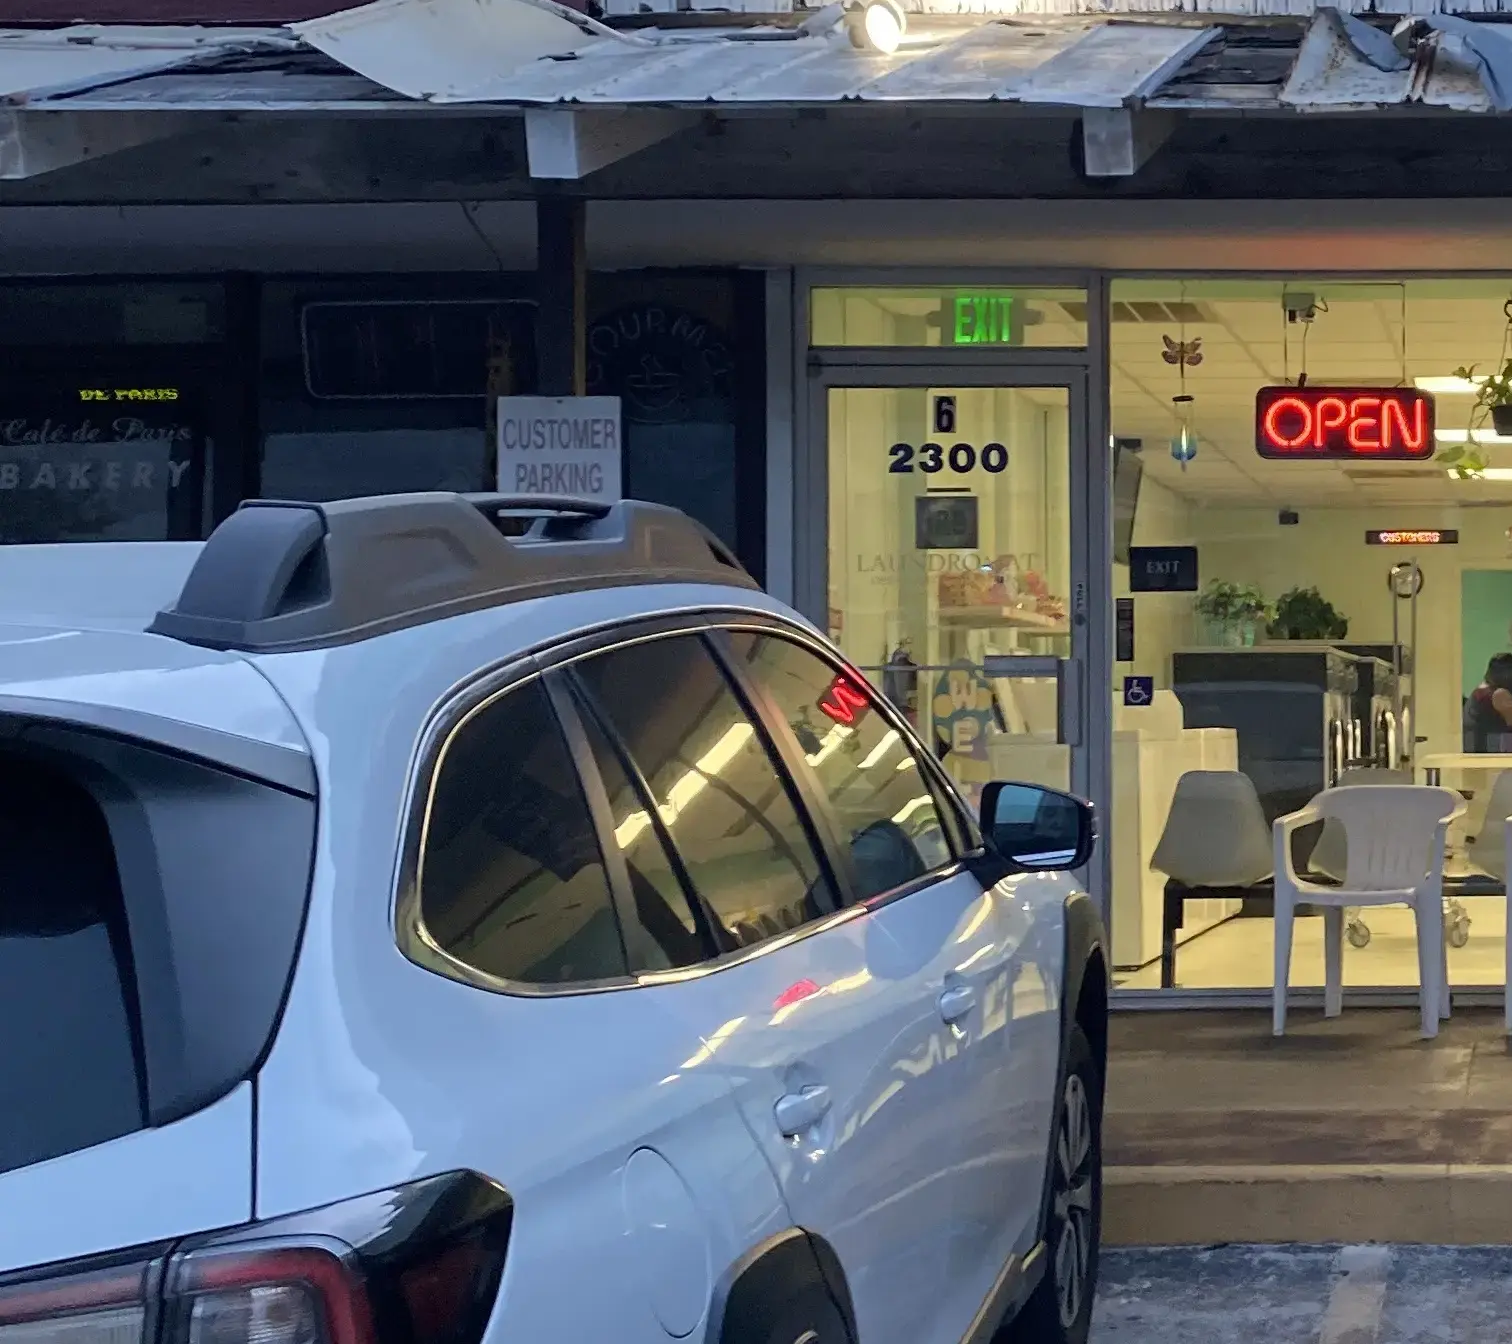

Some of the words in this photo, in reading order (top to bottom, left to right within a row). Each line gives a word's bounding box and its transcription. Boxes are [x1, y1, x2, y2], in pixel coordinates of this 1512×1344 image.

[954, 297, 1013, 343] EXIT
[936, 396, 956, 433] 6
[1265, 397, 1424, 449] OPEN
[503, 419, 617, 449] CUSTOMER
[889, 443, 1009, 473] 2300
[0, 458, 192, 491] BAKERY
[515, 462, 604, 493] PARKING
[1146, 560, 1180, 574] EXIT
